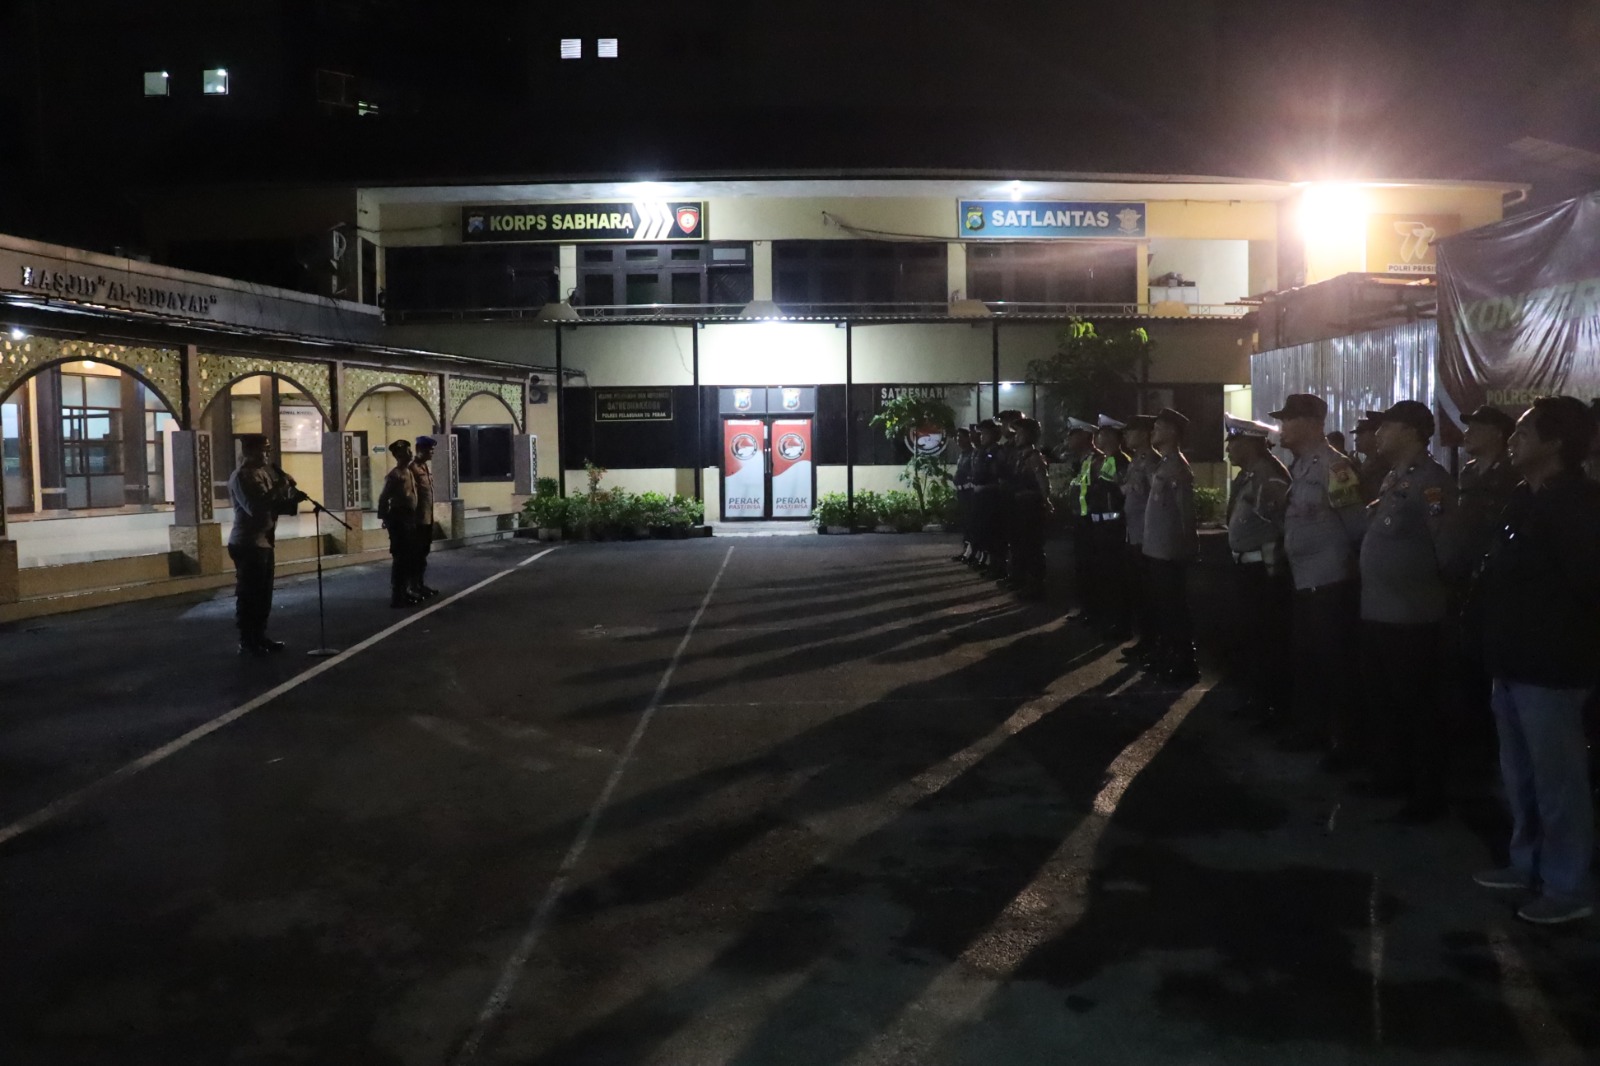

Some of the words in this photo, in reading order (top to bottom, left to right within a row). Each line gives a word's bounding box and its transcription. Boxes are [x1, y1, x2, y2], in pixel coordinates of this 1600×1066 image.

[490, 214, 547, 231] KORPS
[552, 213, 634, 230] SABHARA
[991, 210, 1110, 228] SATLANTAS
[1388, 264, 1411, 272] POLRI
[728, 497, 761, 505] PERAK
